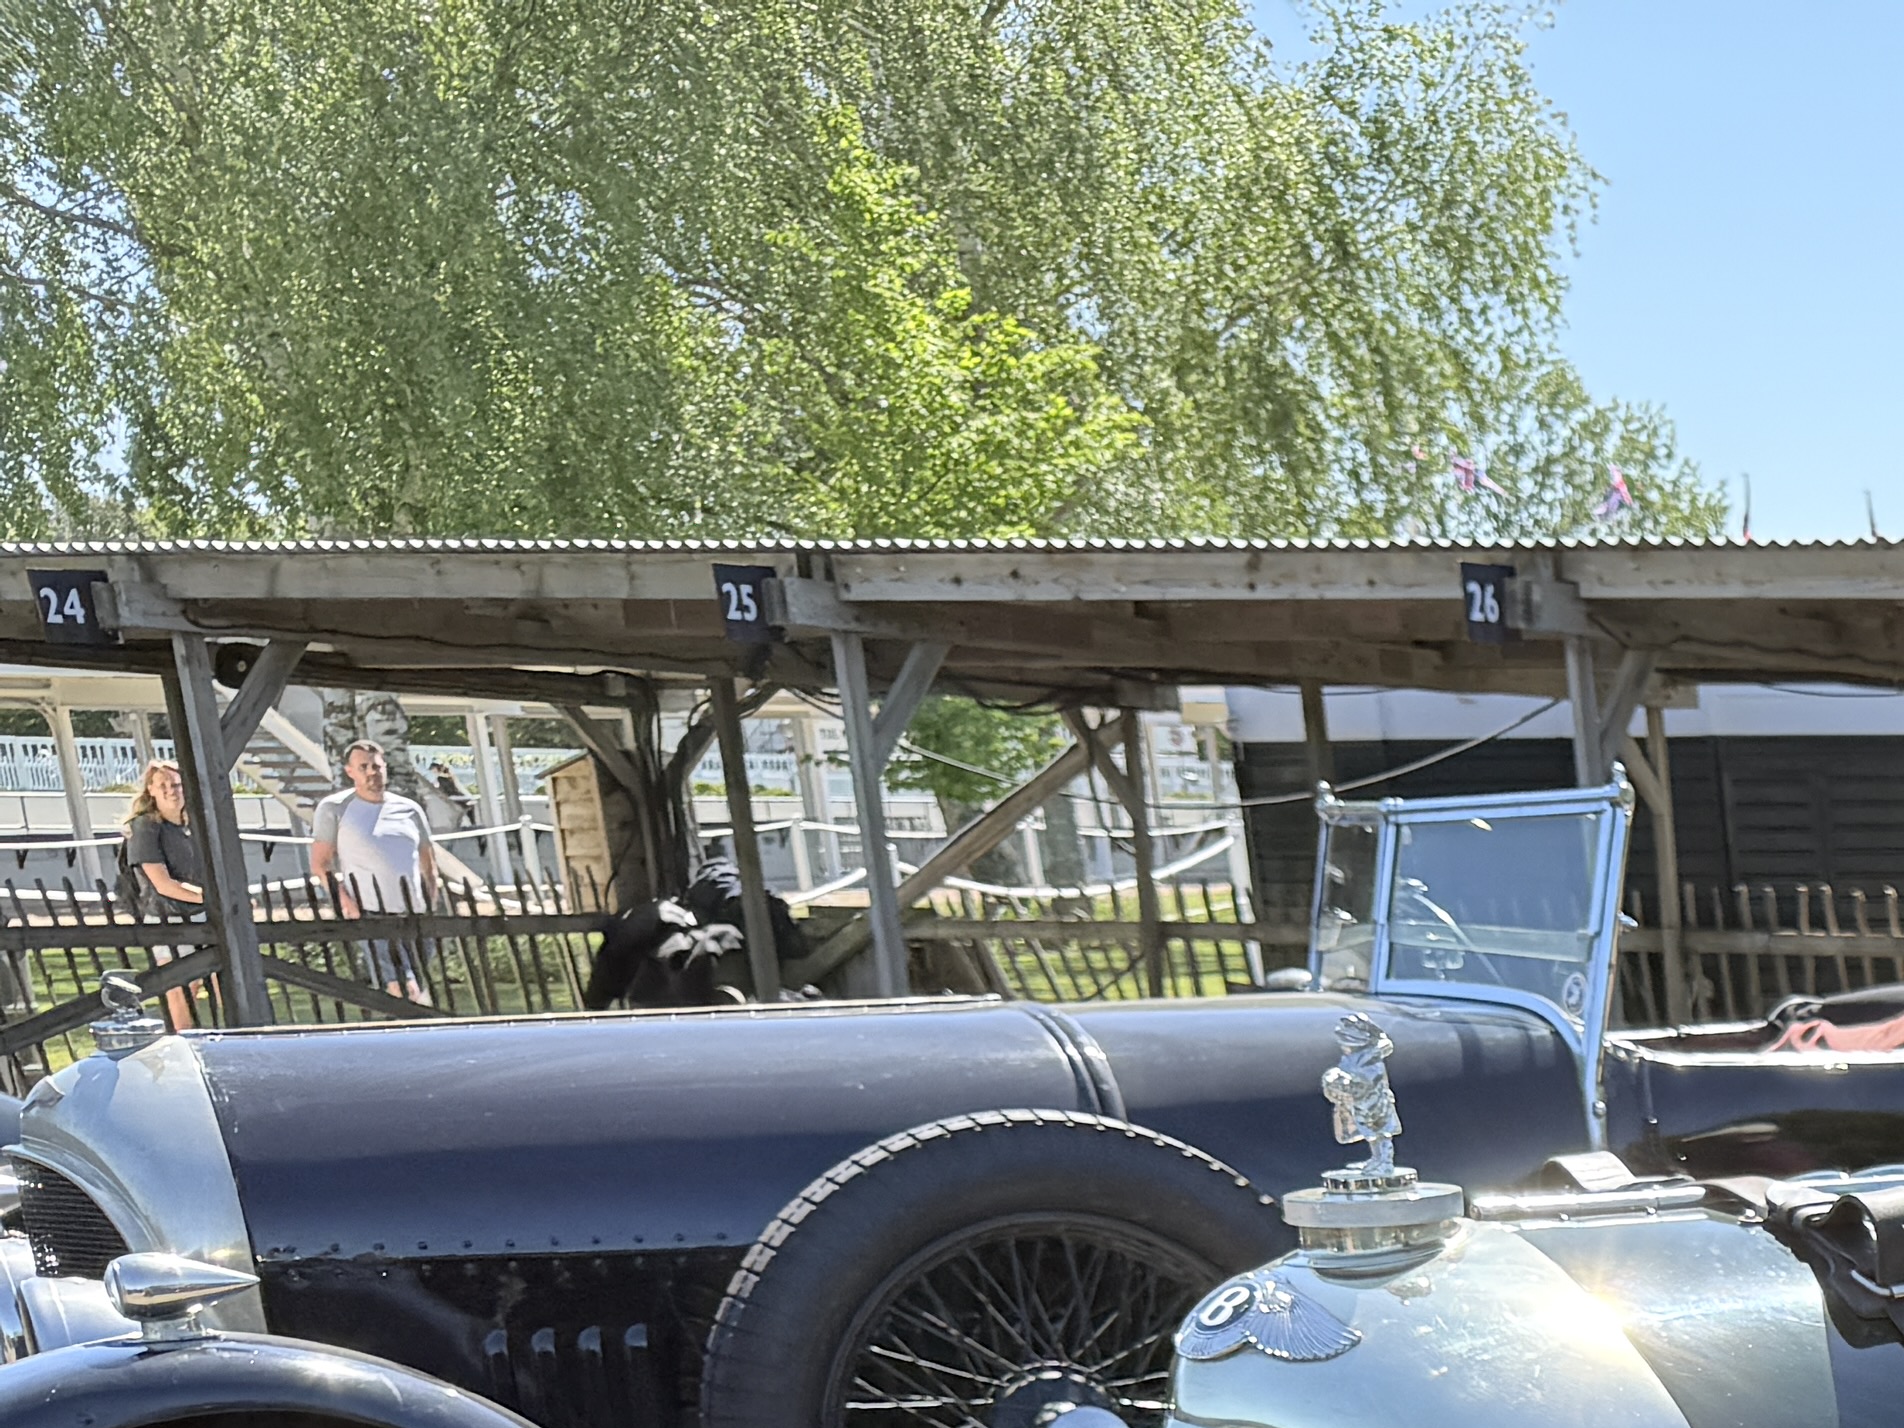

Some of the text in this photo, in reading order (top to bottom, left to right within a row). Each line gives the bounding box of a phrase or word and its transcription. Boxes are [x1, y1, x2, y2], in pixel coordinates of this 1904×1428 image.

[40, 588, 86, 624] 24
[722, 582, 757, 621] 25
[1466, 581, 1500, 624] 26
[1199, 1286, 1250, 1326] B
